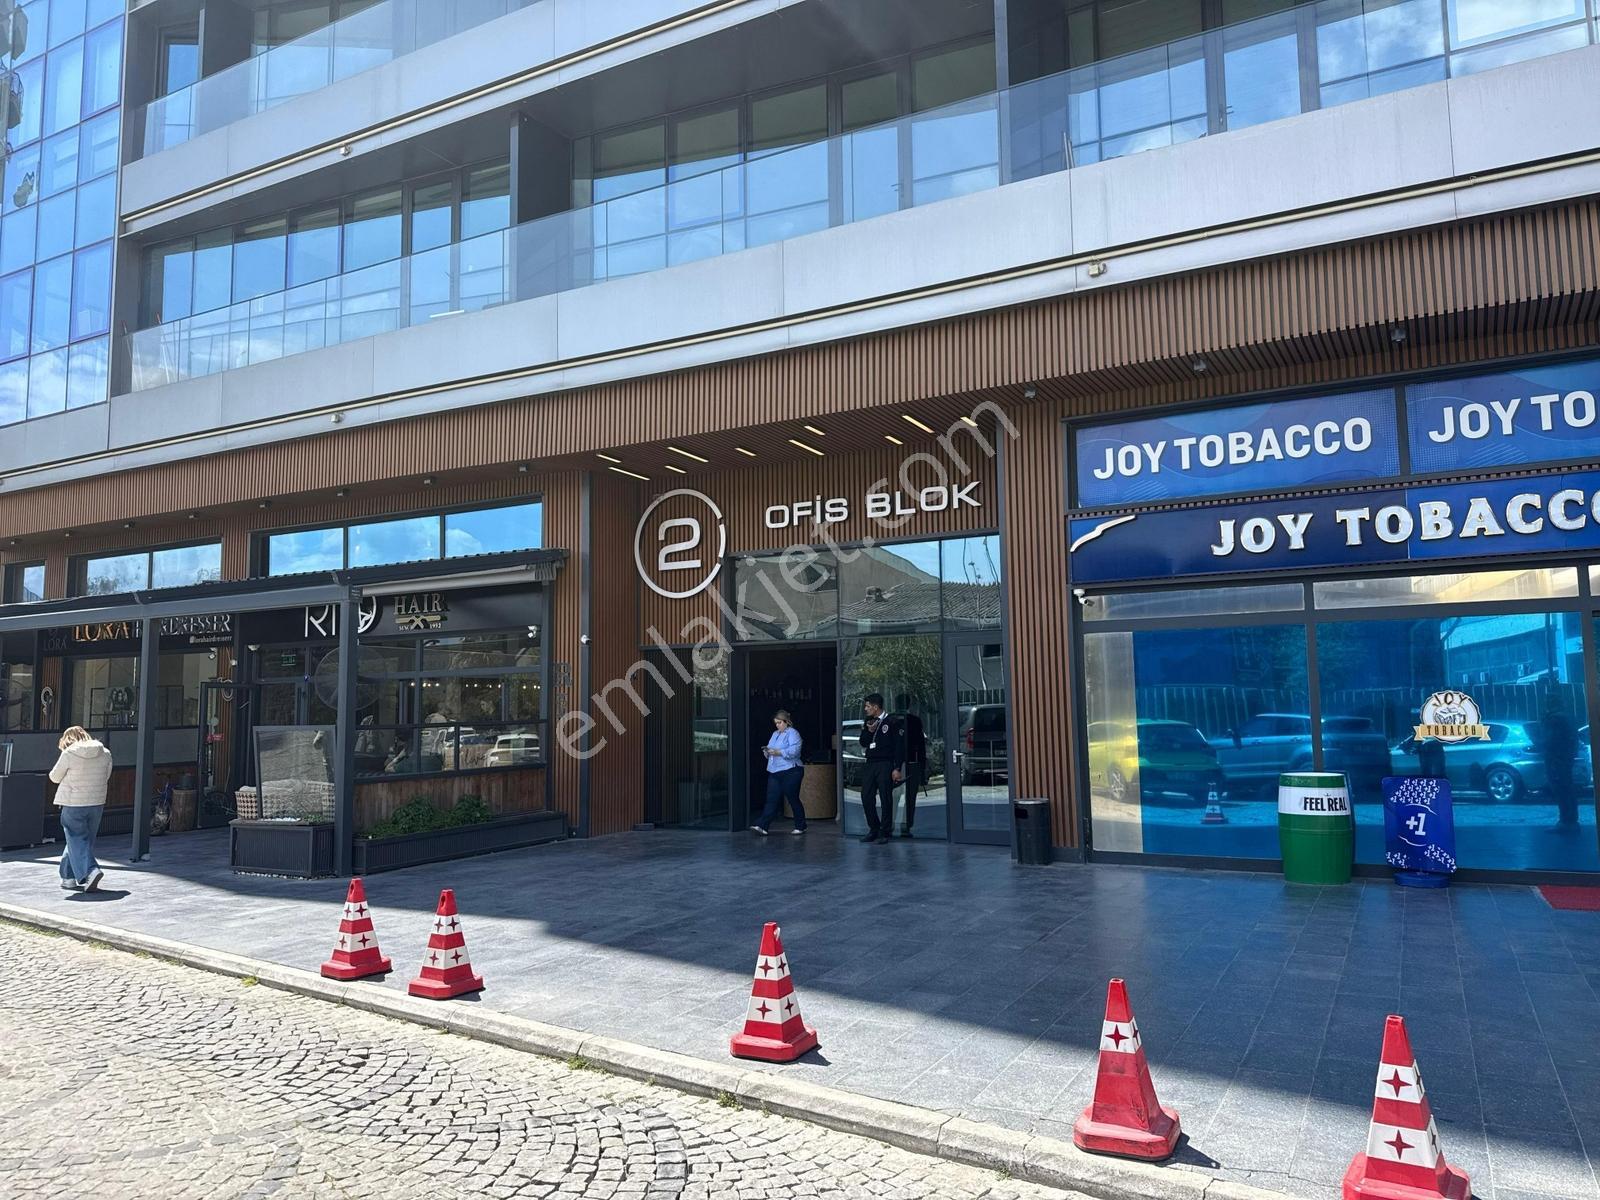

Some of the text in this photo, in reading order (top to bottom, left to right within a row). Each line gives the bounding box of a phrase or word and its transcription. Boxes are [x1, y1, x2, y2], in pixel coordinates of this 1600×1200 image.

[1428, 390, 1596, 444] JOY TO
[1093, 416, 1373, 481] JOY TOBACCO
[867, 481, 981, 519] BLOK
[1210, 488, 1600, 557] JOY TOBACC
[658, 518, 702, 571] 2
[393, 593, 442, 615] HAIR
[1432, 692, 1468, 706] JOY
[1426, 726, 1477, 736] TOBACCO
[1303, 797, 1347, 812] FEEL REAL
[1406, 813, 1426, 836] +1
